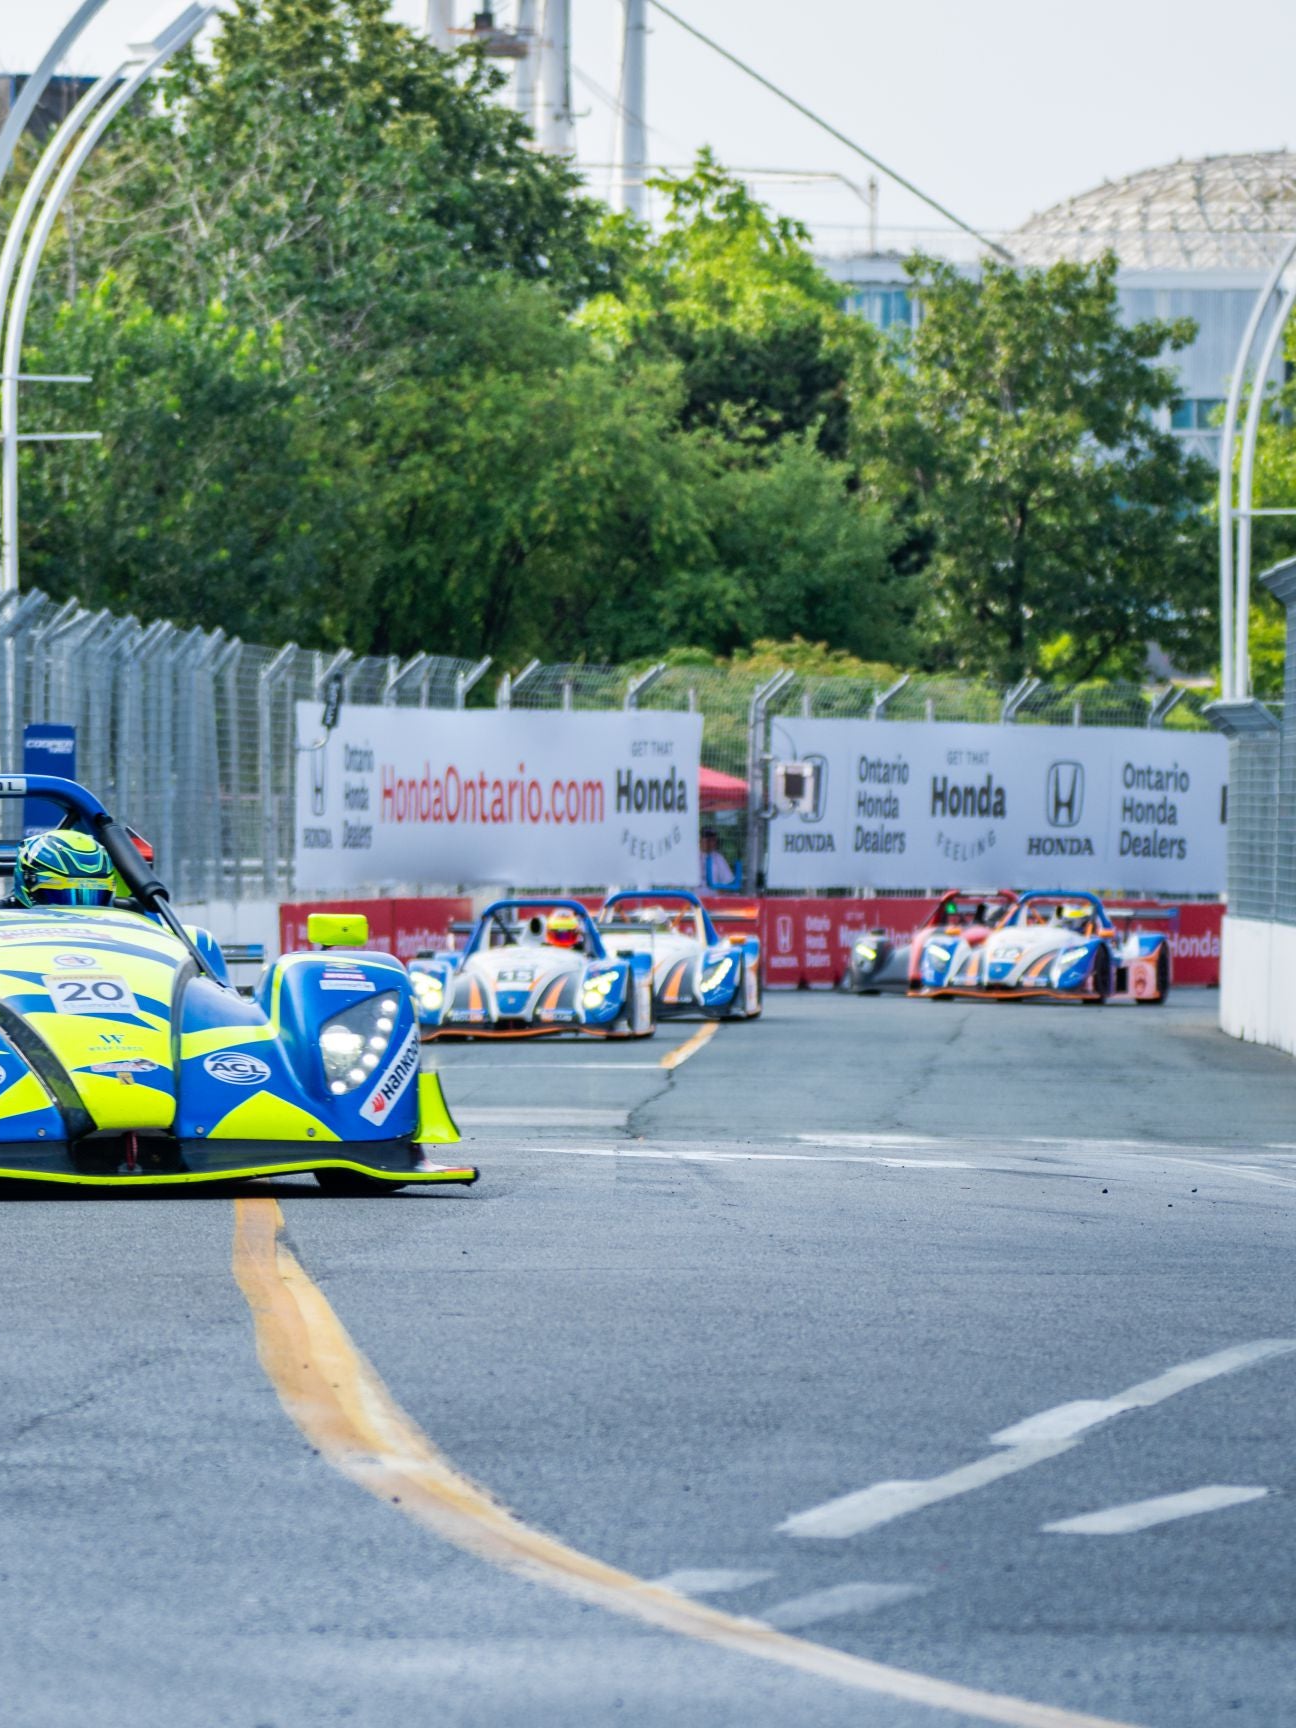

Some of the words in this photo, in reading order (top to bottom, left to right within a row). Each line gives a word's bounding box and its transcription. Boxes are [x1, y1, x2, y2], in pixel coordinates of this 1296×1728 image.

[858, 754, 910, 785] Ontario
[1122, 761, 1190, 793] Ontario
[381, 761, 605, 823] HondaOntario.com
[616, 766, 688, 814] Honda
[856, 790, 900, 820] Honda
[931, 774, 1007, 820] Honda
[1121, 796, 1179, 826] Honda
[784, 833, 836, 852] HONDA
[855, 825, 906, 854] Dealers
[1027, 837, 1095, 856] HONDA
[1119, 829, 1187, 860] Dealers
[57, 982, 125, 1002] 20
[210, 1062, 267, 1074] ACL
